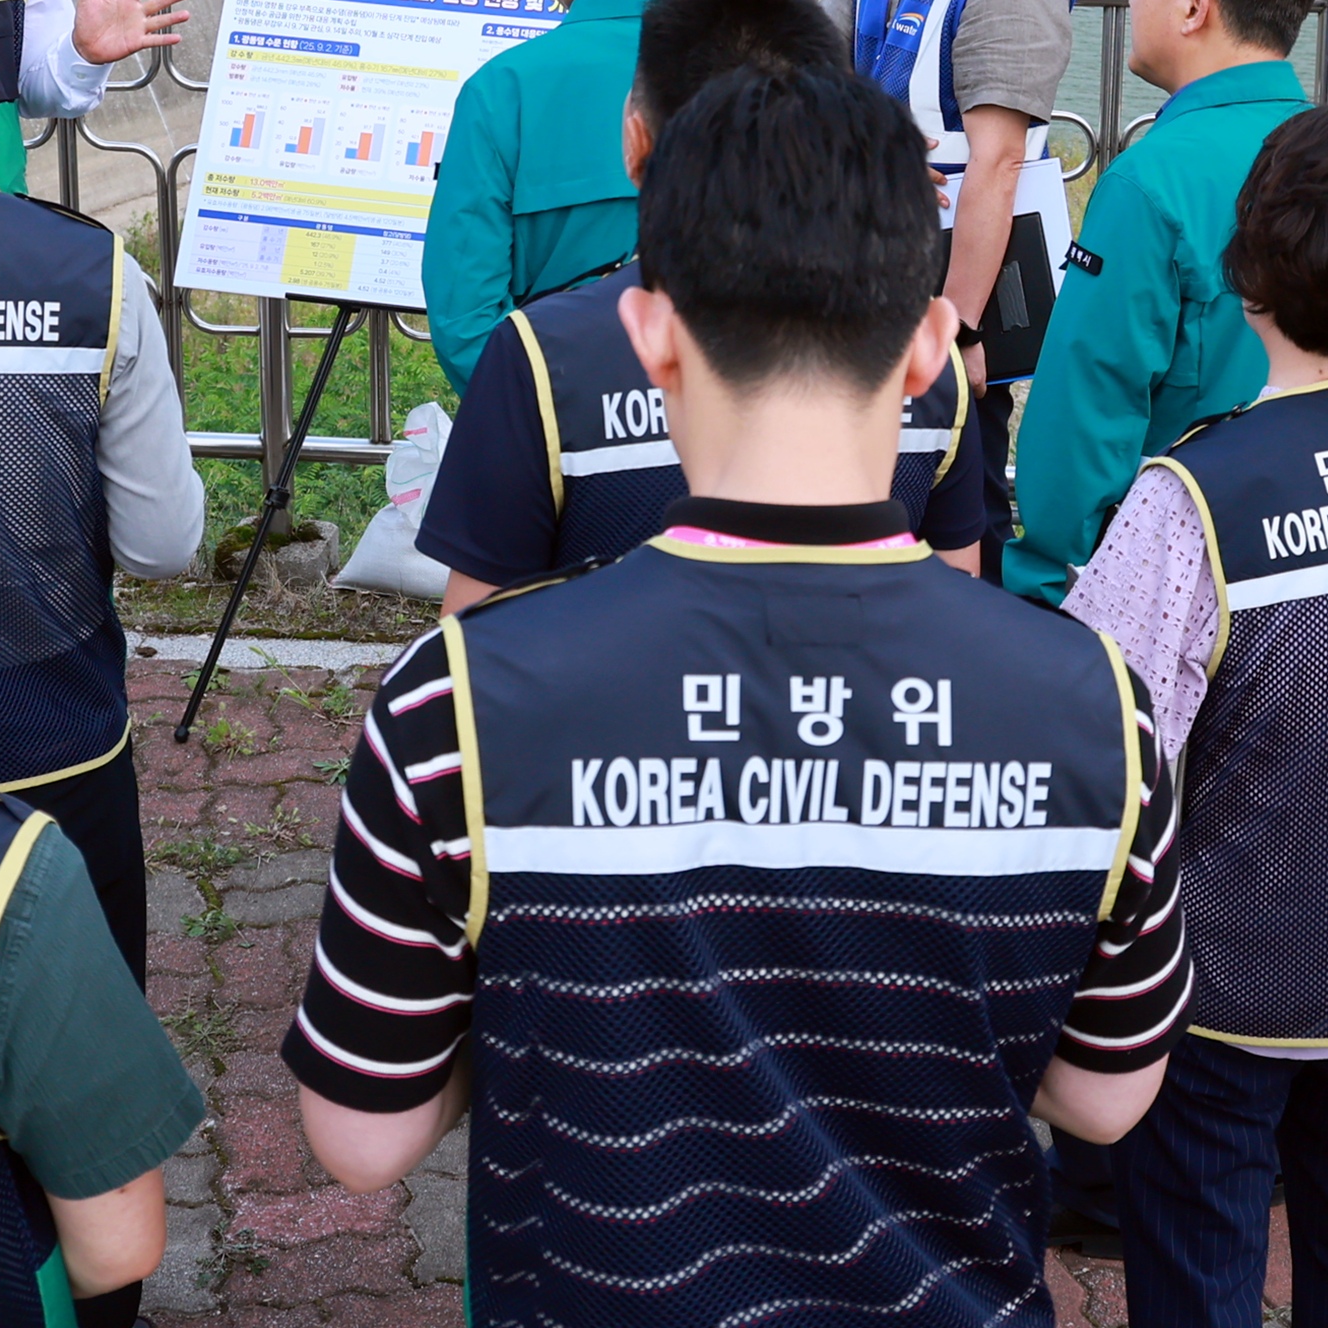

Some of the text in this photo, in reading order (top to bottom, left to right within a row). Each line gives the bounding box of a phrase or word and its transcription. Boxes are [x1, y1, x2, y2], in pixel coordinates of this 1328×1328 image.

[486, 26, 520, 38] 2. 용수댐
[234, 35, 240, 43] 1.
[241, 35, 265, 46] 광동댐
[265, 37, 283, 48] 수문
[283, 39, 299, 49] 현황
[334, 44, 354, 55] 기준)
[215, 174, 236, 184] 저수량
[205, 185, 219, 195] 현재
[219, 187, 240, 197] 저수량
[602, 387, 669, 440] KOR
[682, 673, 953, 747] 민 방 위
[572, 755, 1052, 828] KOREA CIVIL DEFENSE
